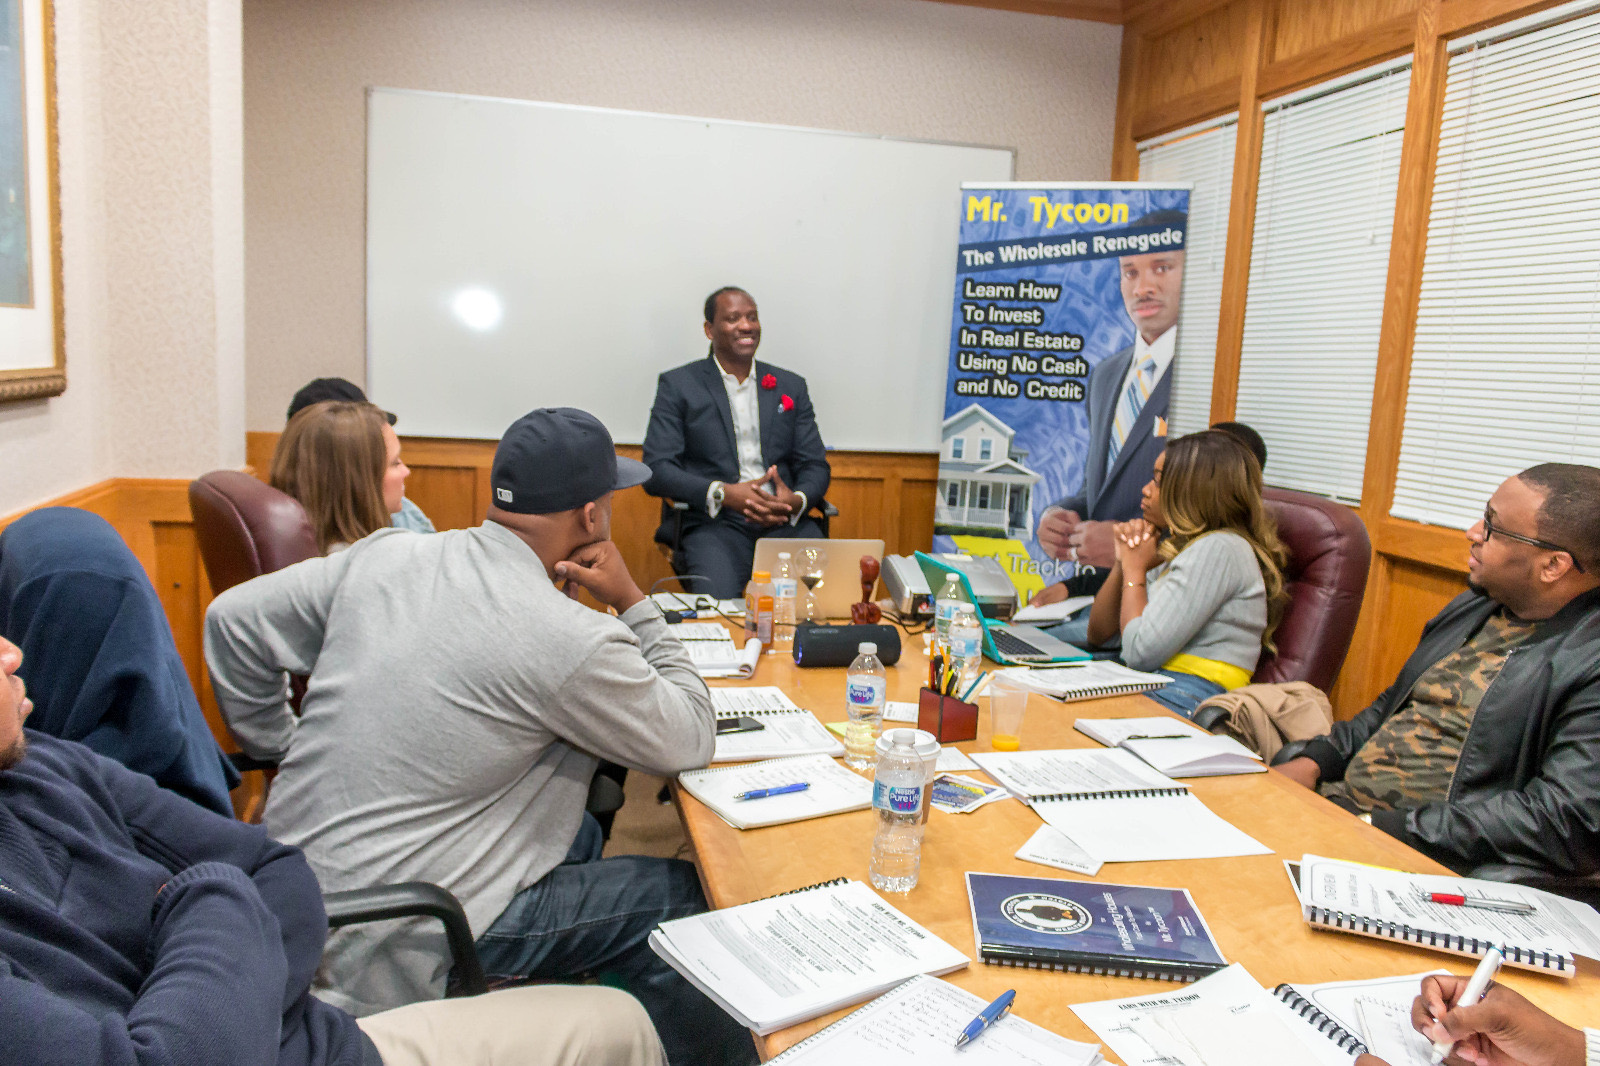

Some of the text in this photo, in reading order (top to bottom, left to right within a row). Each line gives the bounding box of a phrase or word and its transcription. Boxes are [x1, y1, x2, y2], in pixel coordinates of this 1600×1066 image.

[966, 196, 1129, 228] Mr. Tycoon
[962, 228, 1183, 267] The Wholesale Renegade
[965, 281, 1059, 300] Learn How
[964, 305, 1041, 324] To Invest
[961, 330, 1082, 350] In Real Estate
[959, 354, 1086, 375] Using No Cash
[957, 379, 1083, 399] and No Credit
[1008, 553, 1067, 578] Track
[890, 793, 909, 802] Pure
